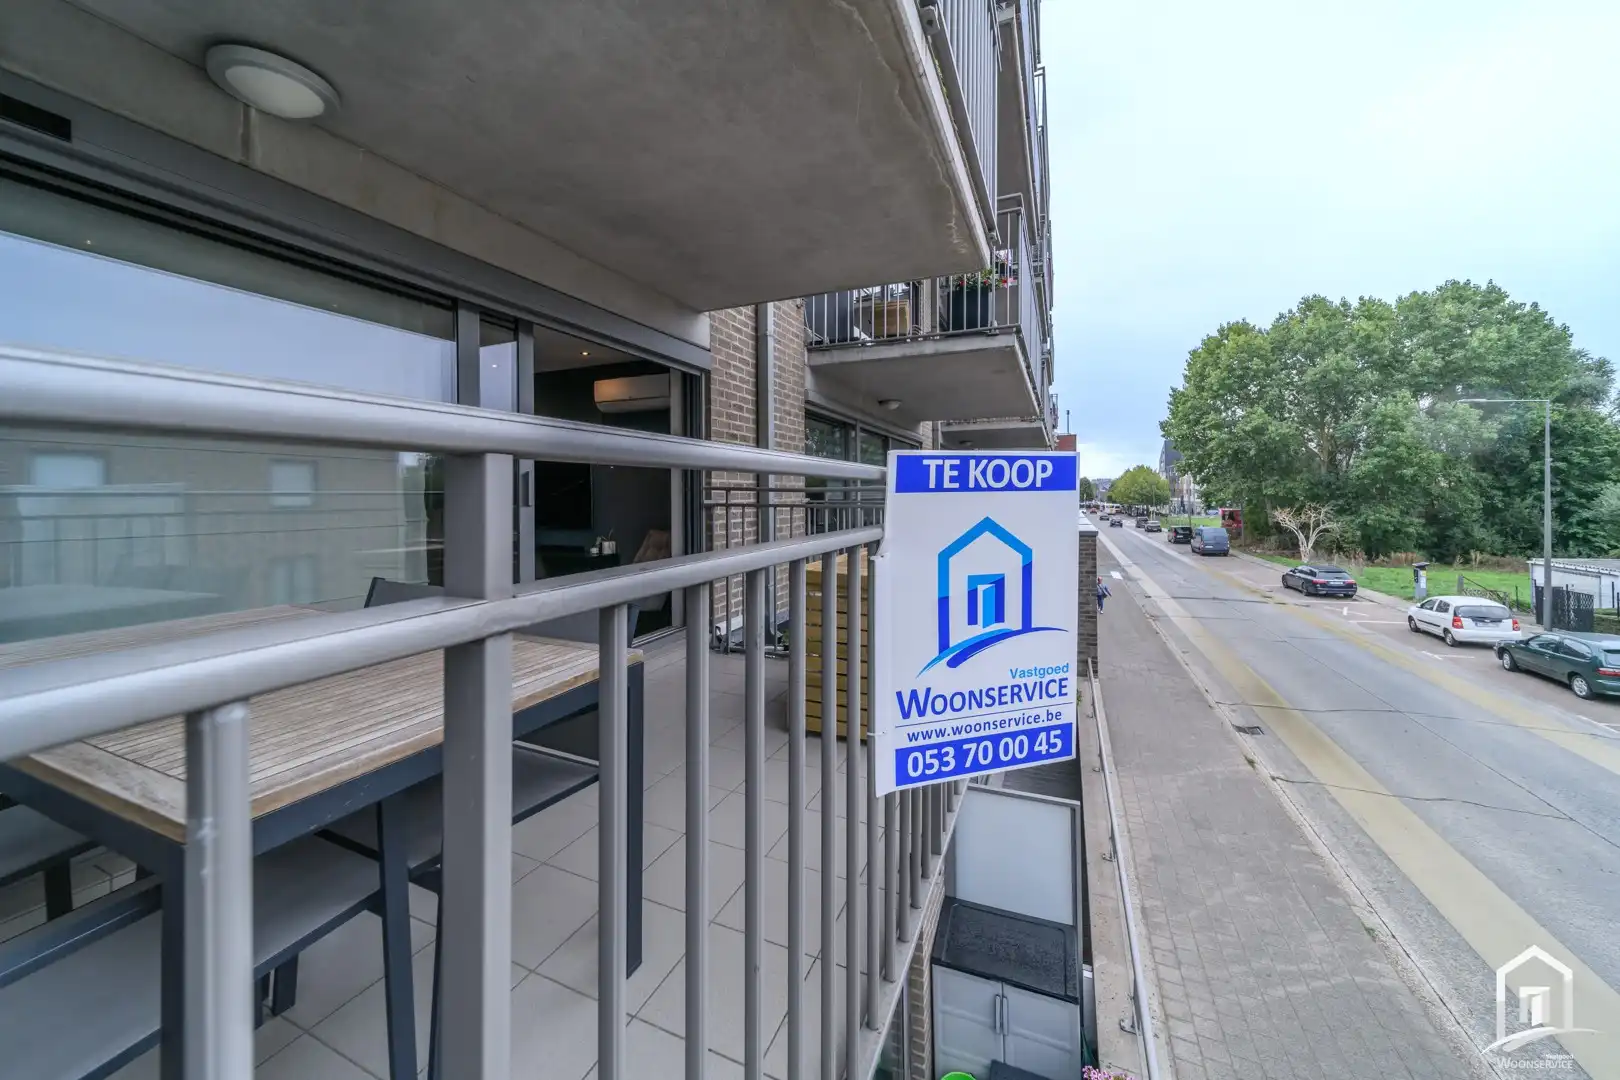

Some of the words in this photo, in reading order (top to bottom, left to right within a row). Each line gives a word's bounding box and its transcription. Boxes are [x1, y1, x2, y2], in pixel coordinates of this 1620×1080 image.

[923, 459, 960, 489] TE
[968, 458, 1053, 488] KOOP
[1010, 663, 1069, 679] Vastgoed
[895, 677, 1069, 720] WOONSERVICE
[907, 709, 1062, 742] www.woonservice.be
[907, 746, 956, 778] 053
[962, 740, 993, 768] 70
[999, 736, 1028, 760] 00
[1034, 729, 1063, 755] 45
